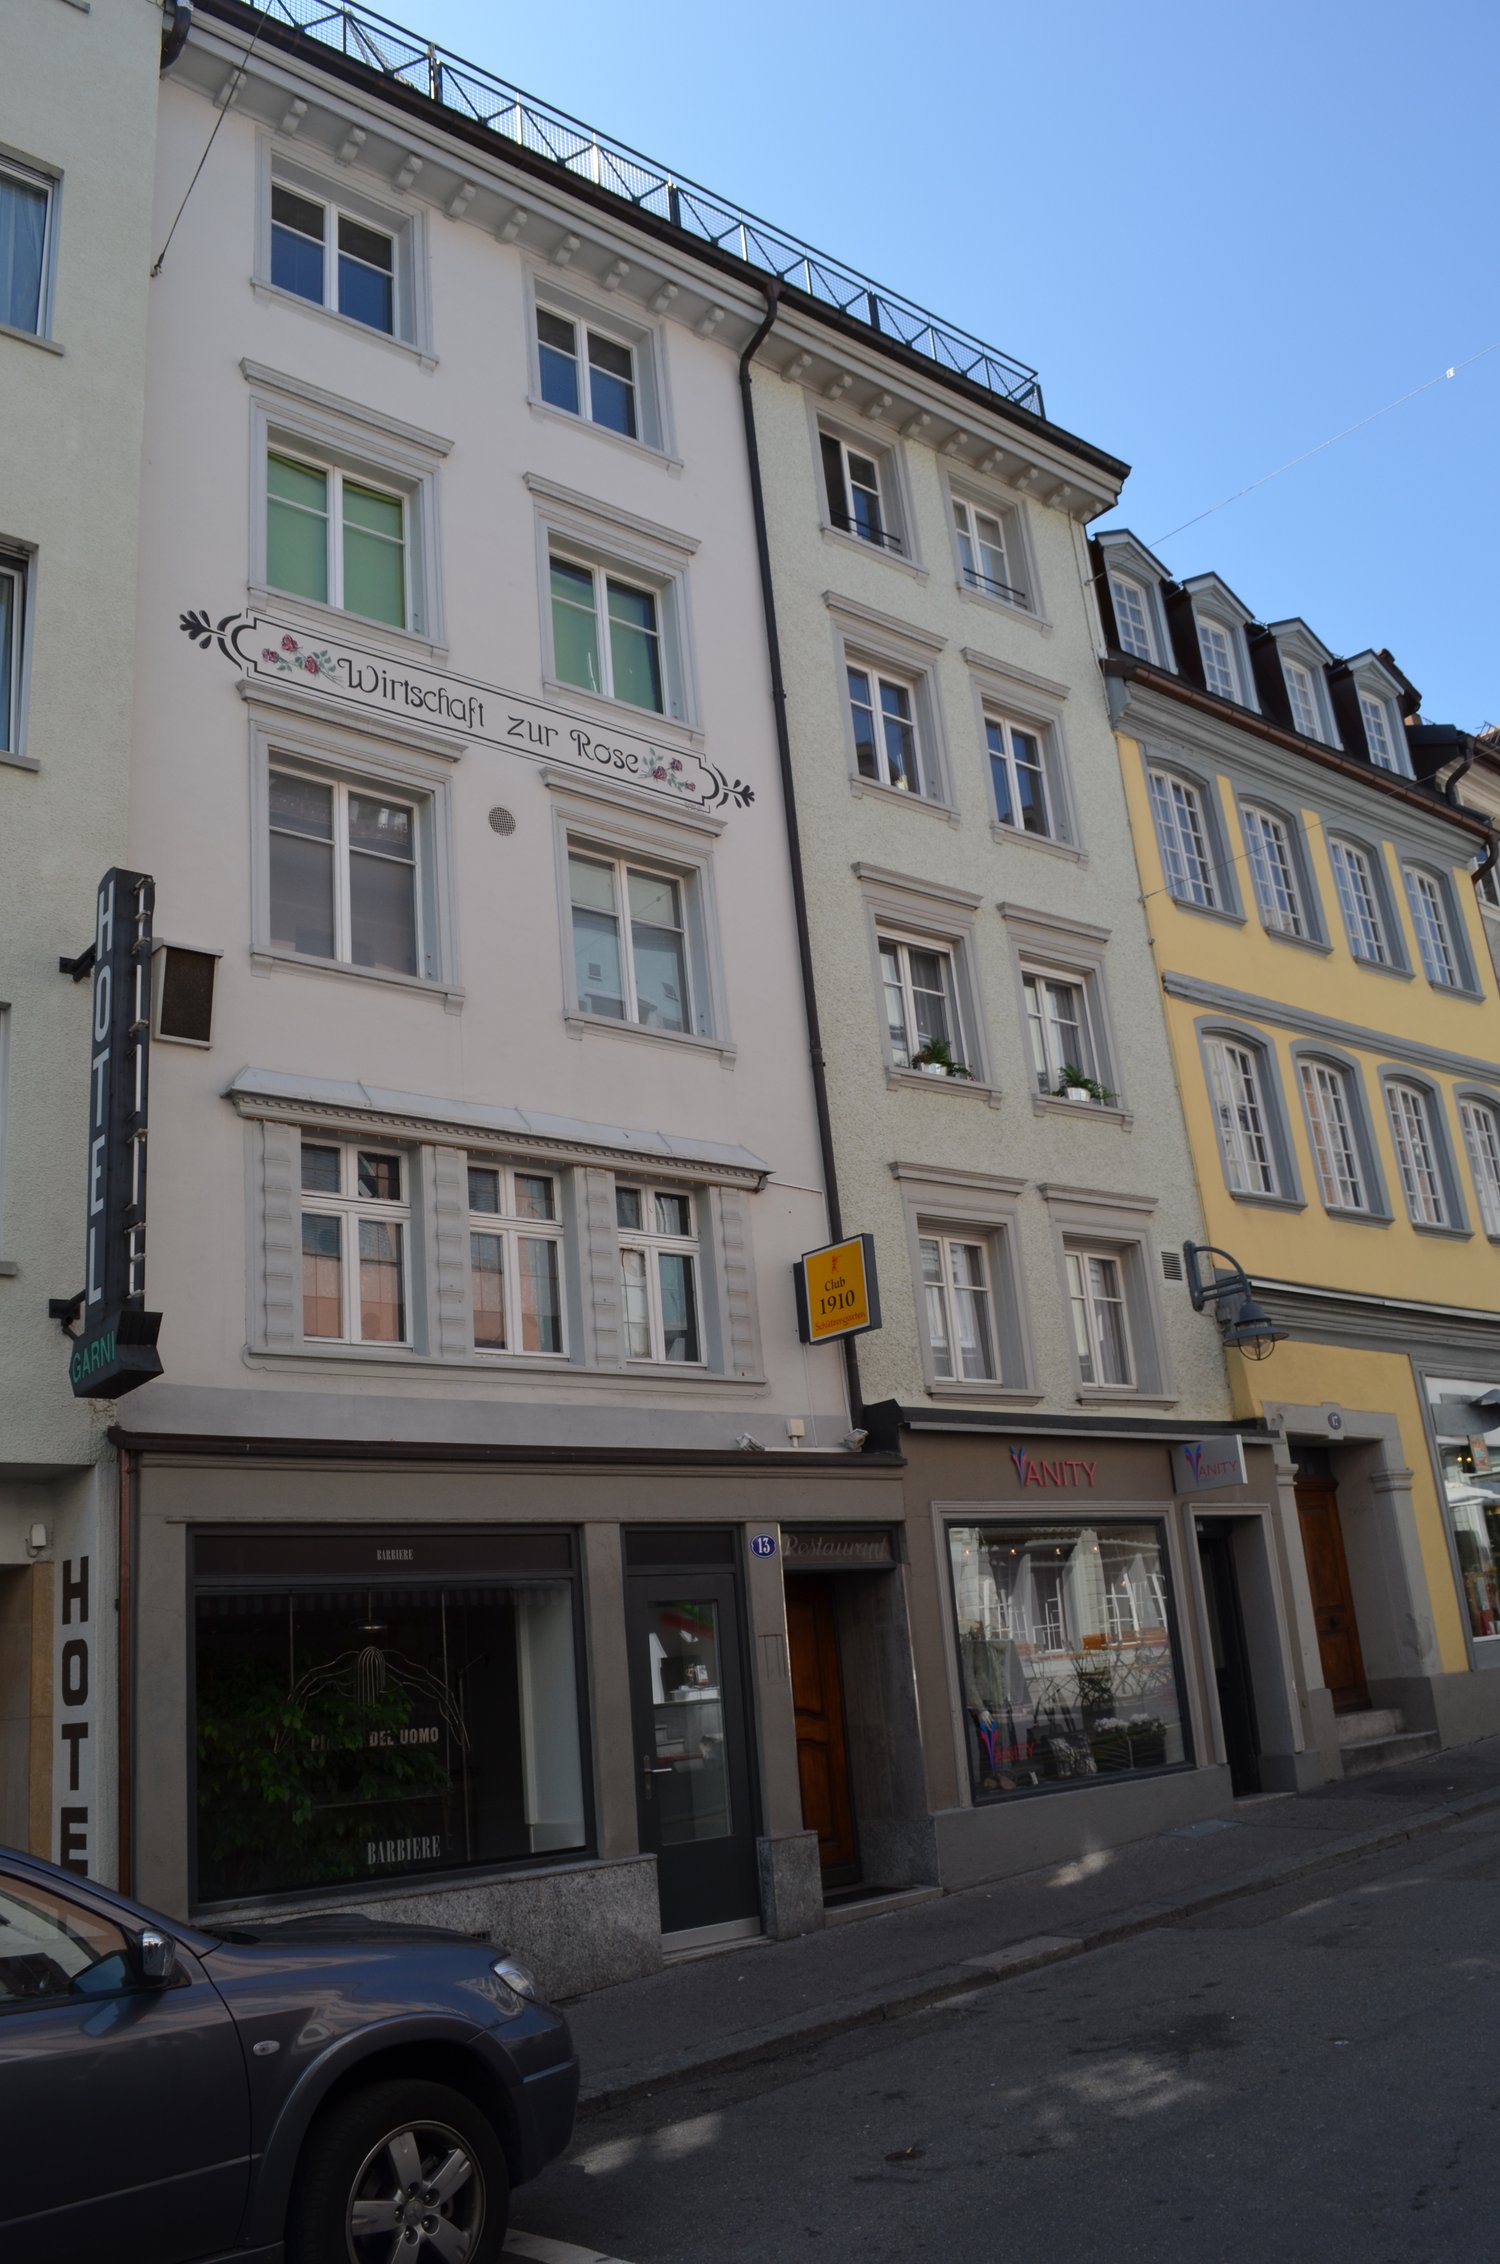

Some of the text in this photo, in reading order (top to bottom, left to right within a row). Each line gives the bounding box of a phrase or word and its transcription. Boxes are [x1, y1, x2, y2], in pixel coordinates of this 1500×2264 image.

[336, 658, 640, 774] Wirtschaft zur Rose
[88, 879, 115, 1306] HOTEL
[825, 1276, 846, 1292] Club
[820, 1290, 855, 1315] 1910
[72, 1329, 117, 1384] GARNI
[1010, 1446, 1097, 1488] VANITY
[1184, 1444, 1238, 1488] VANITY
[376, 1549, 414, 1561] BARBIERE
[757, 1537, 771, 1554] 13
[784, 1535, 890, 1561] Restaurant
[60, 1555, 90, 1878] HOTE
[399, 1727, 439, 1745] UOMO
[367, 1836, 441, 1866] BARBIERE
